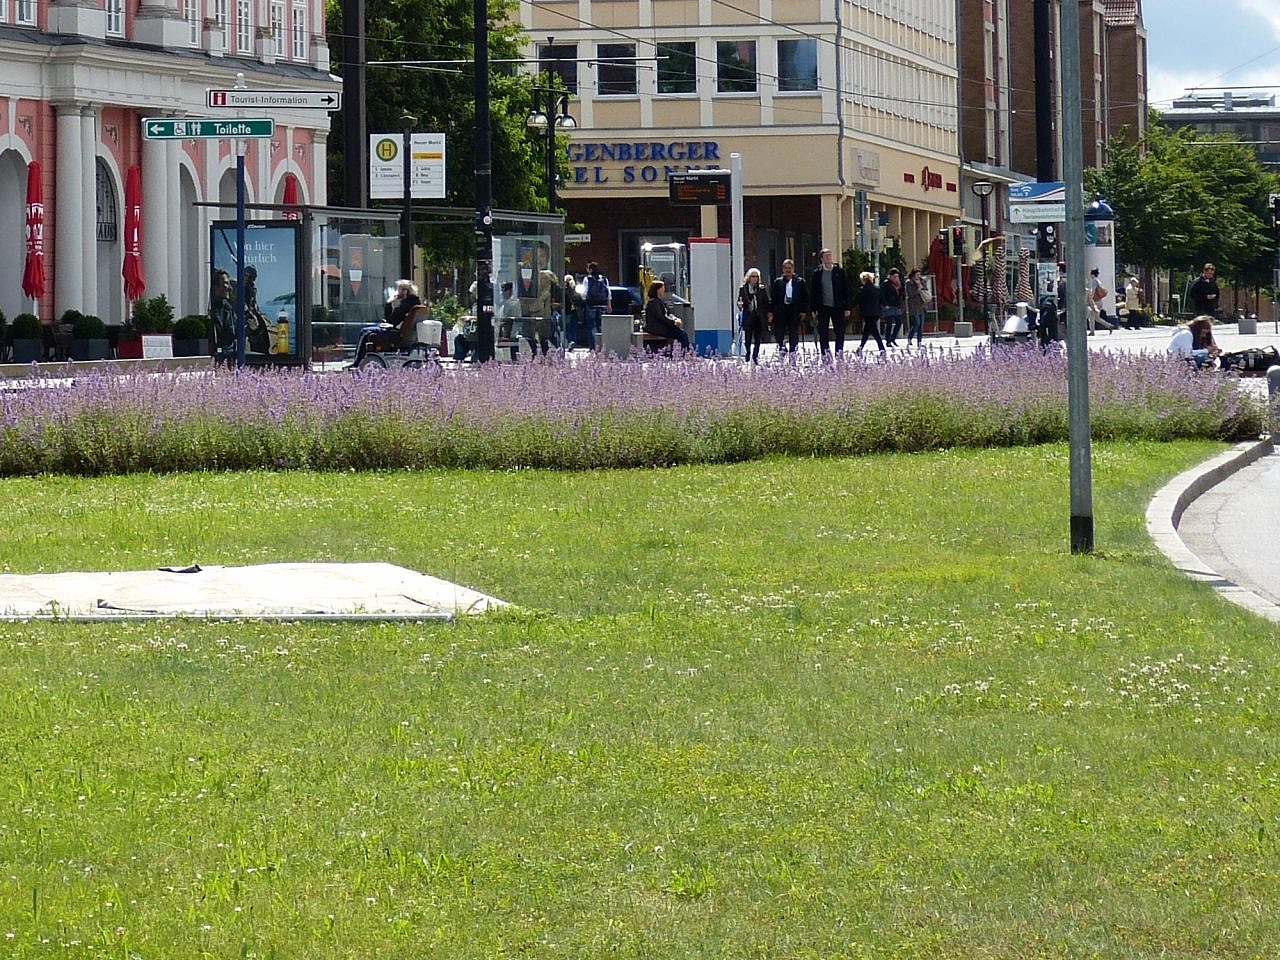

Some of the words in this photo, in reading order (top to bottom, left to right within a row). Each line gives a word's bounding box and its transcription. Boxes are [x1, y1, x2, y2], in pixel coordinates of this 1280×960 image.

[231, 91, 308, 104] Tourist-Information
[214, 123, 251, 135] Toilette
[567, 142, 720, 161] GENBERGER
